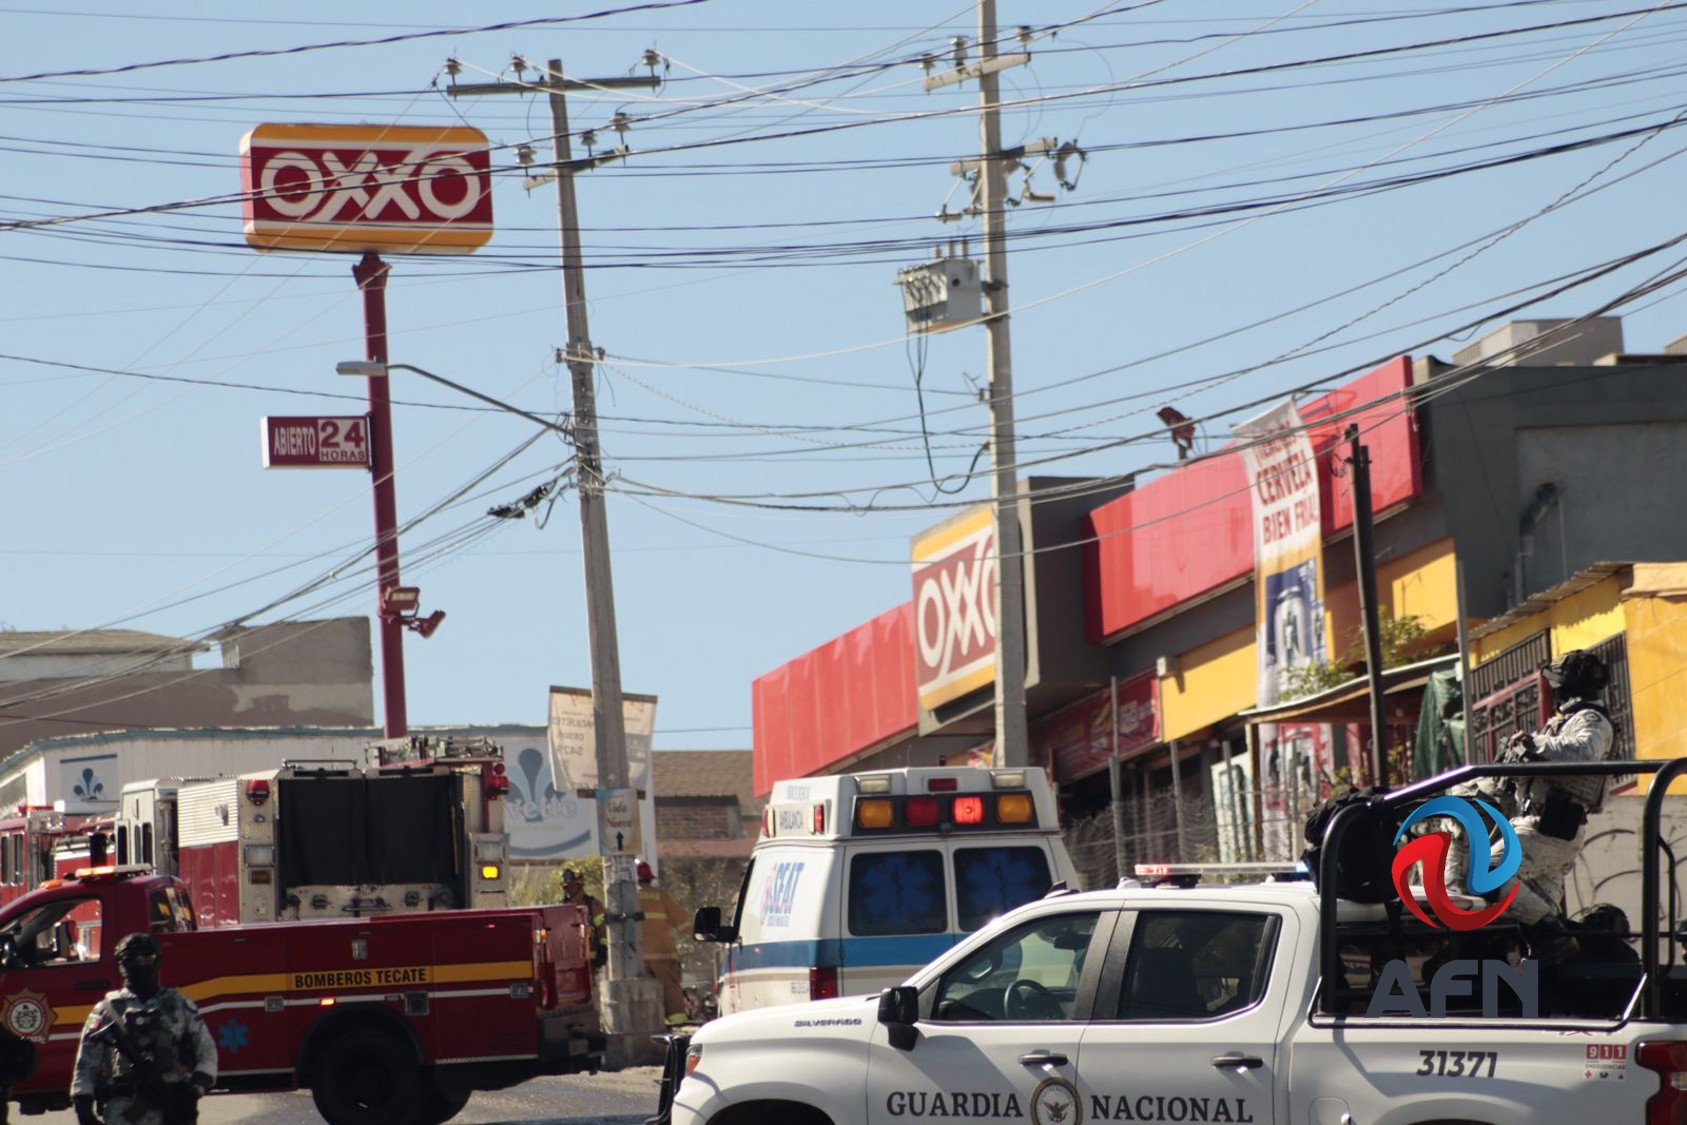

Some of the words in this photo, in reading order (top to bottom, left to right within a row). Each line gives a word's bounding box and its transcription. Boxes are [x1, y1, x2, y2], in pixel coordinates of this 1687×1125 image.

[261, 150, 481, 222] OXXO
[274, 427, 317, 456] ABIERTO
[320, 421, 365, 449] 24
[321, 450, 366, 461] HORAS
[1256, 450, 1313, 506] CERVEZA
[1262, 507, 1293, 545] BIEN
[295, 969, 372, 989] BOMBEROS
[377, 968, 427, 984] TECATE
[794, 1018, 862, 1028] SILVERADO
[1416, 1050, 1498, 1078] 31371
[1587, 1045, 1626, 1059] 911
[887, 1091, 1024, 1118] GUARDIA
[1090, 1094, 1254, 1123] NACIONAL
